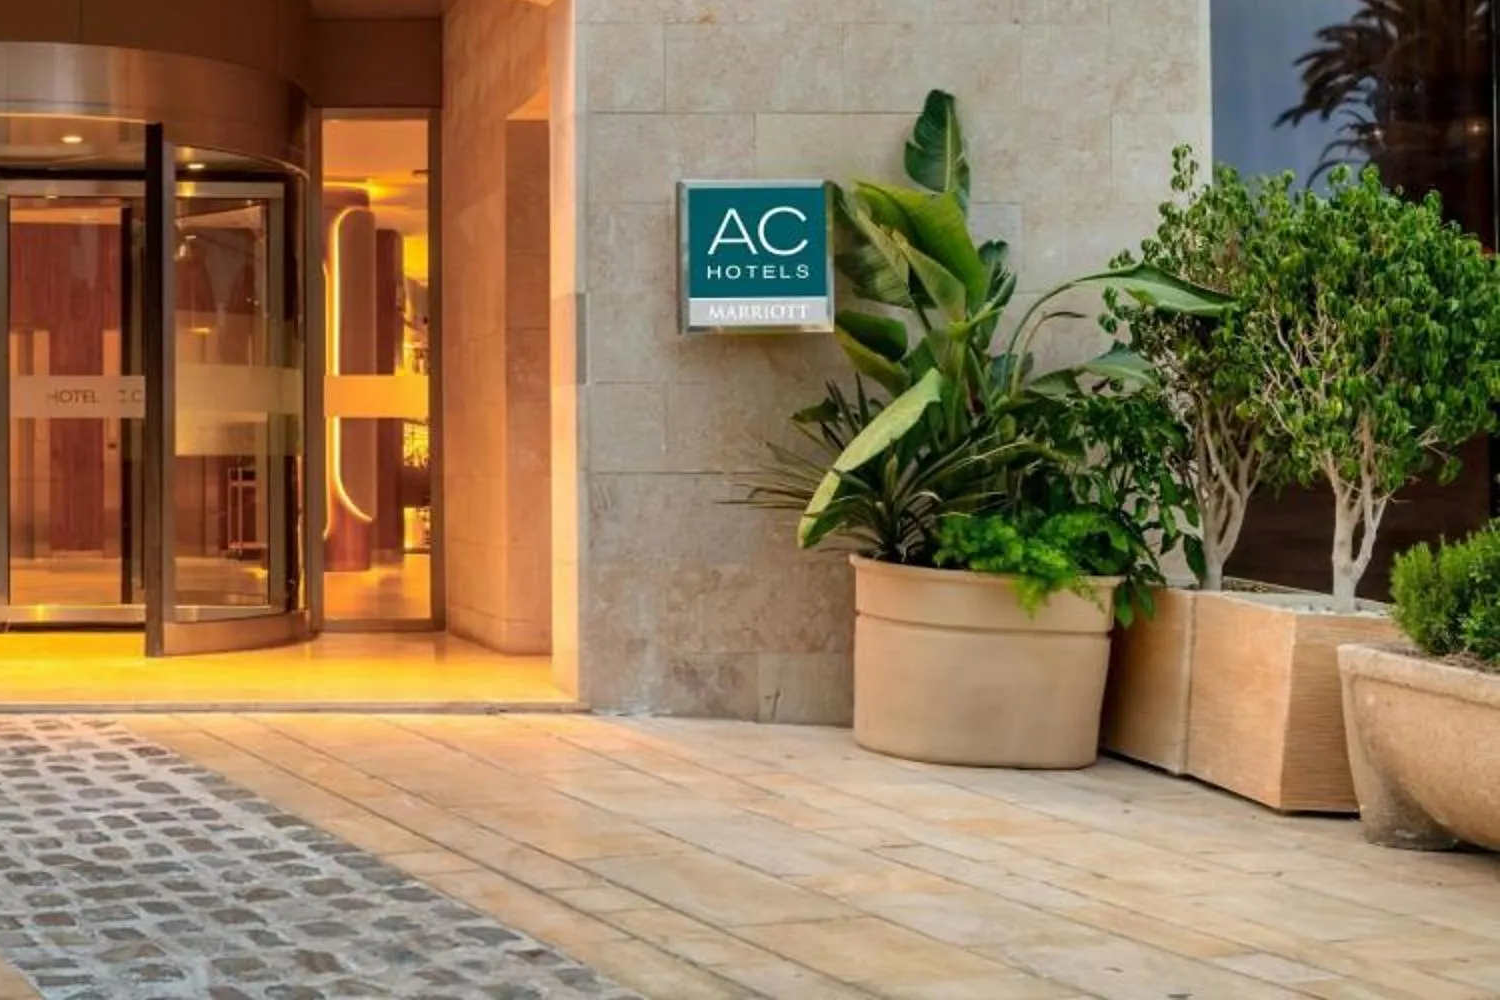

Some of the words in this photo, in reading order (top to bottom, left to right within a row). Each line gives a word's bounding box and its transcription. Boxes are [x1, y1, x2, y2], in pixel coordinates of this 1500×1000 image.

[707, 206, 809, 256] AC
[707, 264, 809, 279] HOTELS
[708, 304, 809, 320] MARRIOTT
